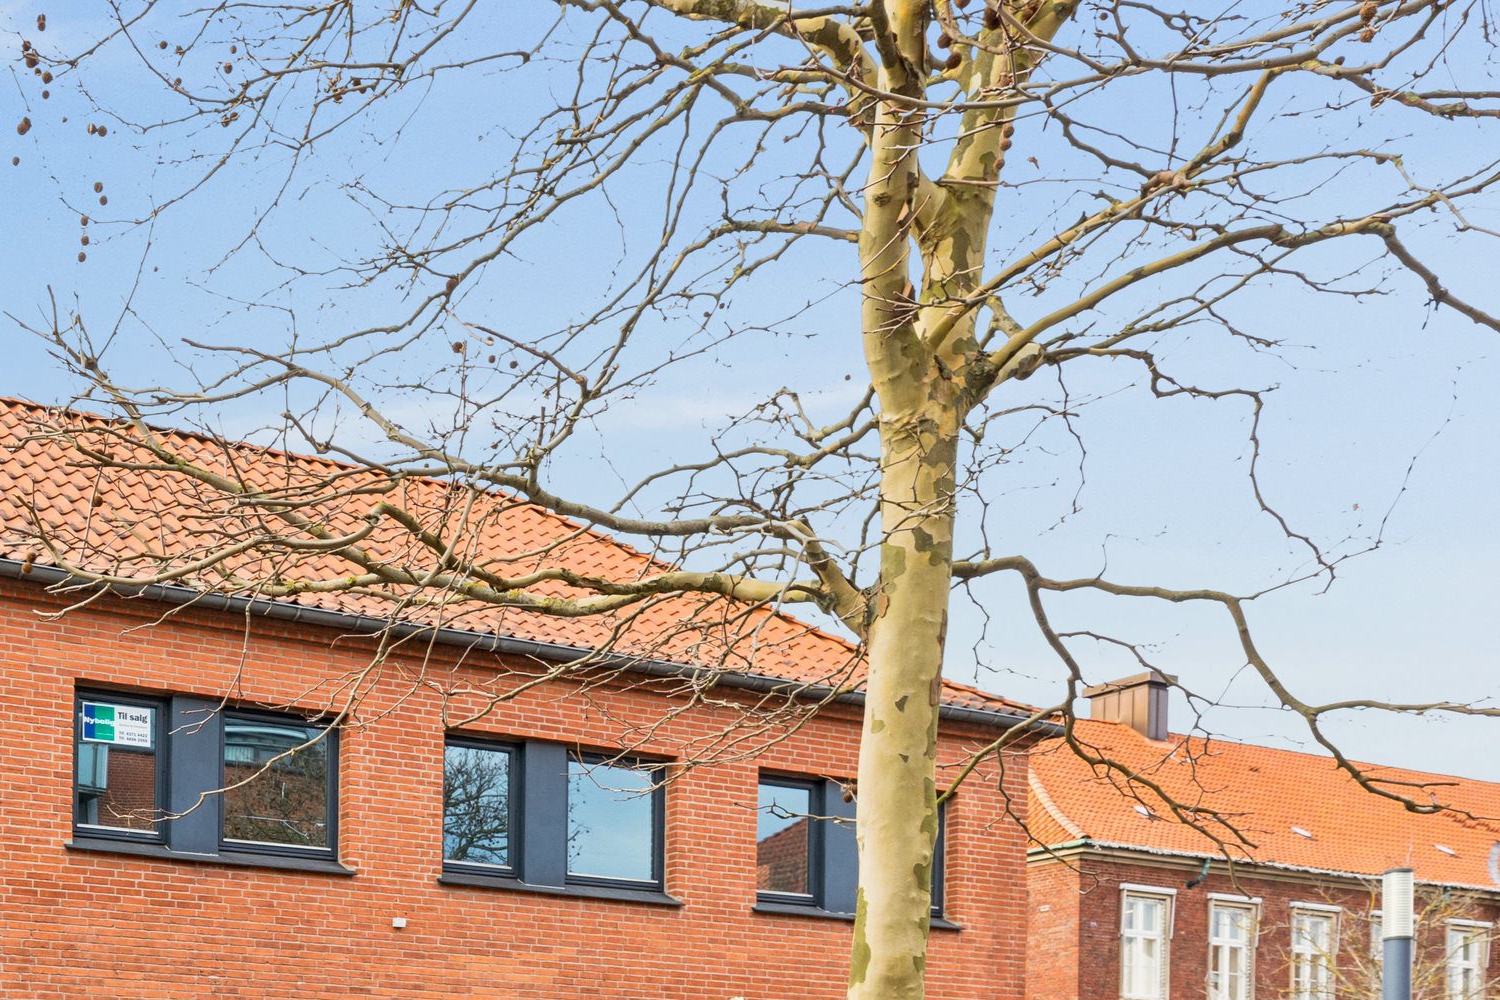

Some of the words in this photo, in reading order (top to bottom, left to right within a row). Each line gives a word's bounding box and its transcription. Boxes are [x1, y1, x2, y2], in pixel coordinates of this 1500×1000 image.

[83, 716, 115, 727] Nybolig
[118, 712, 127, 720] Til
[129, 714, 148, 724] salg
